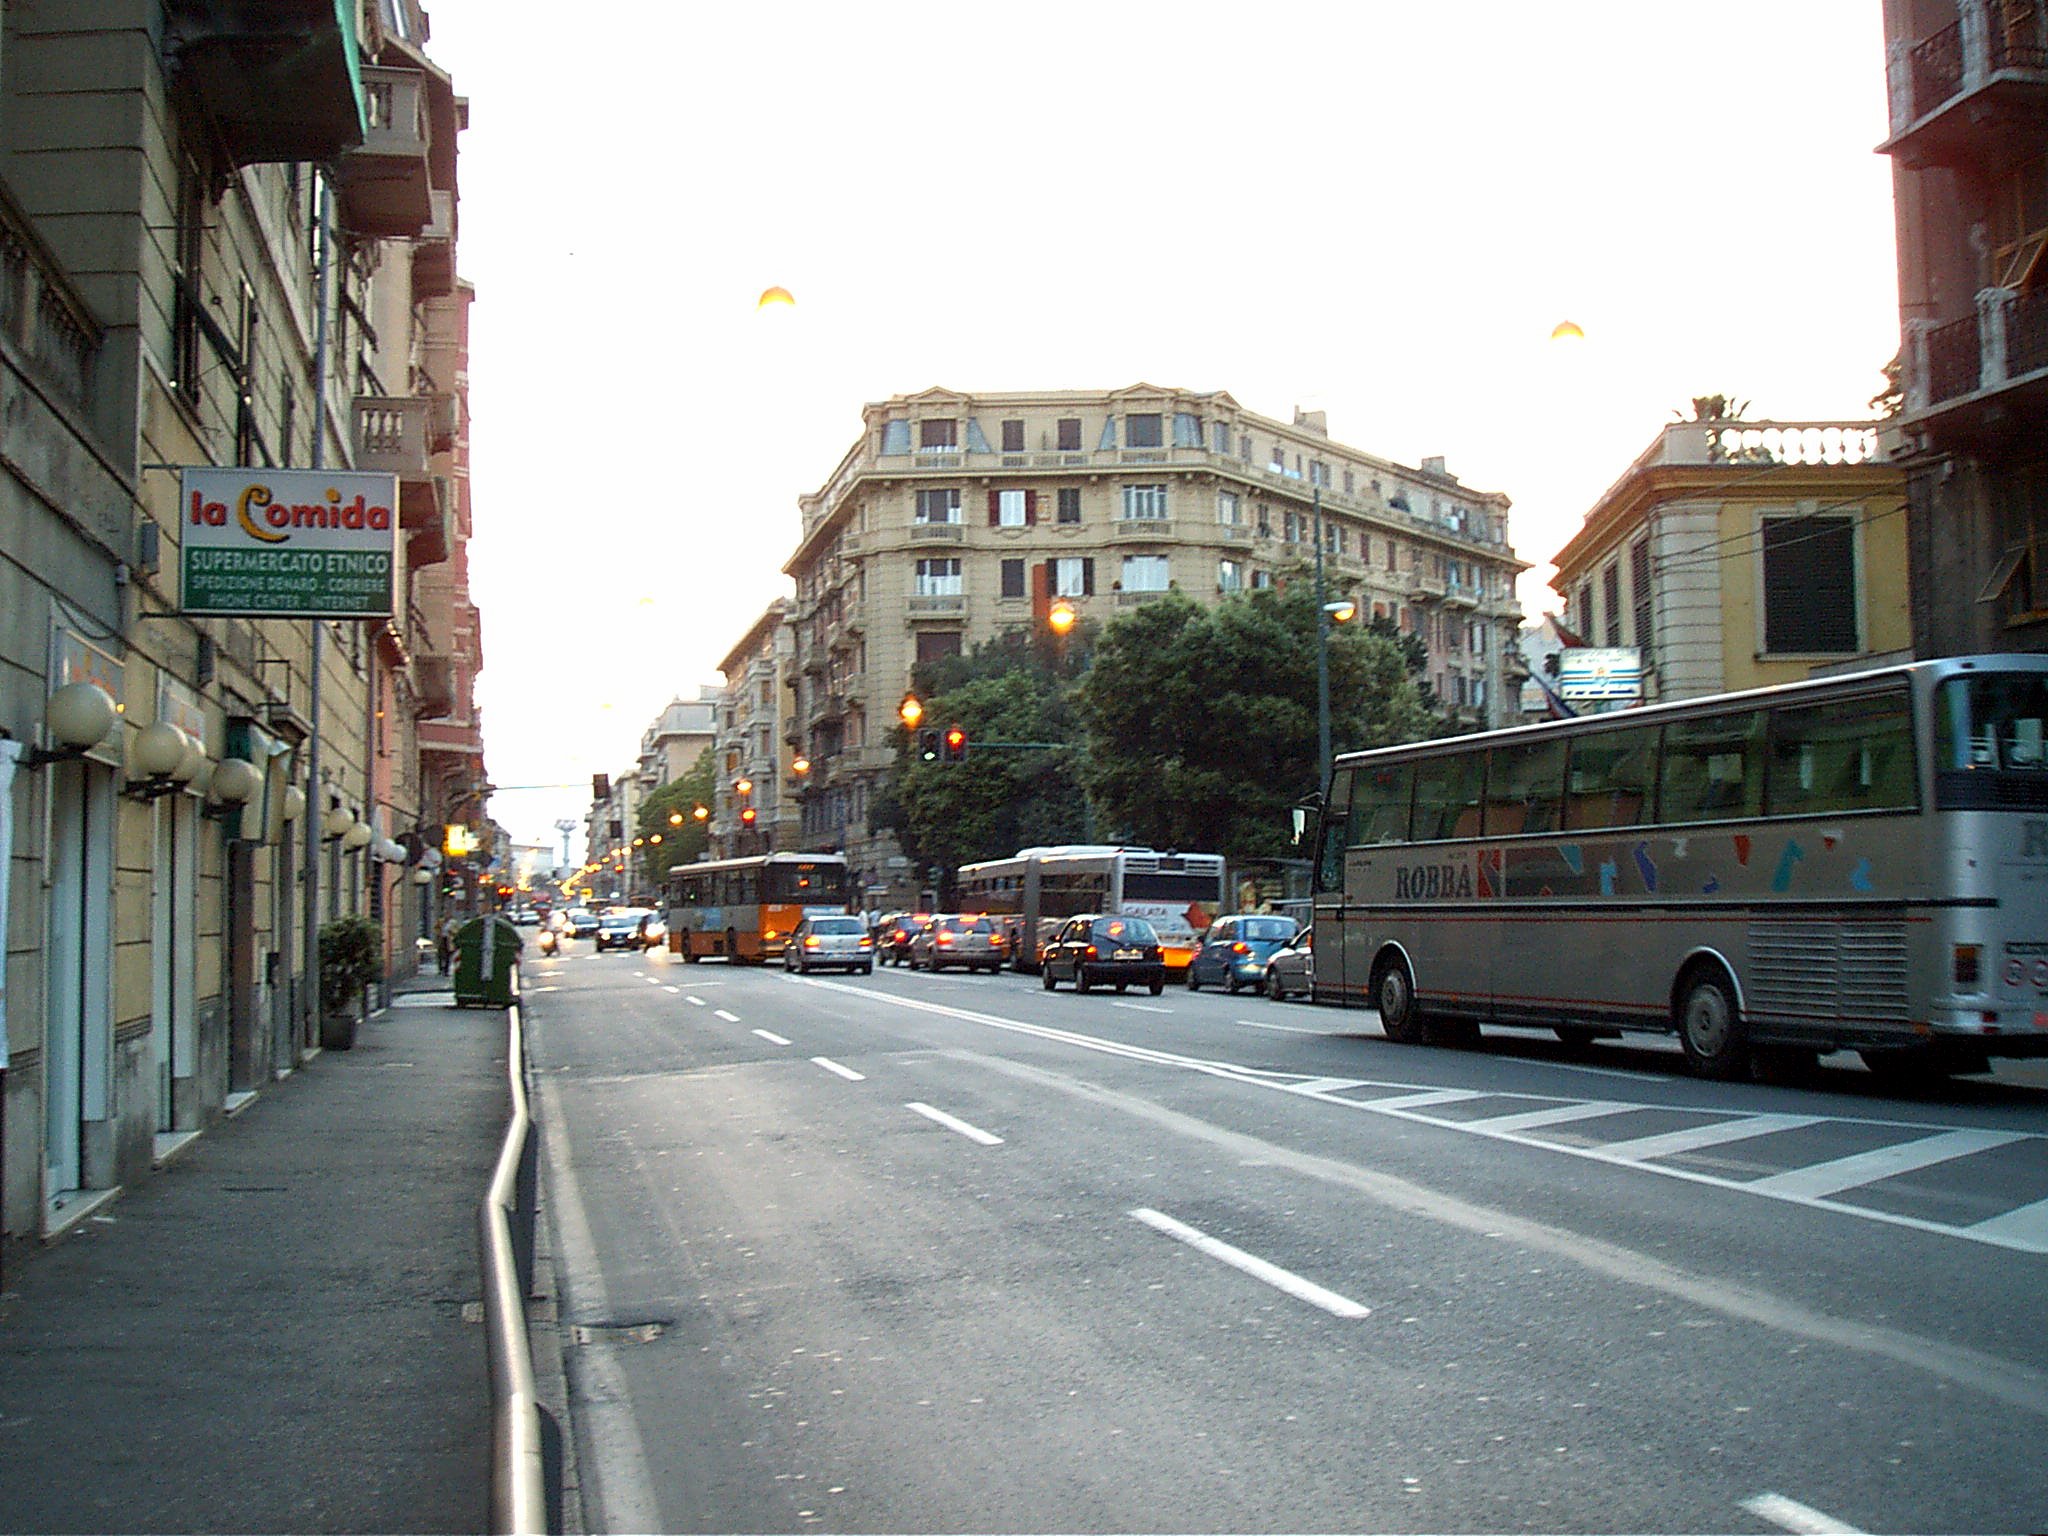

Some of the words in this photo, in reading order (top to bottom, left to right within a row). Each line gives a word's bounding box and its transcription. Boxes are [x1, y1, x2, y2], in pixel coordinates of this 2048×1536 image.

[190, 489, 227, 526] la
[236, 484, 390, 543] Comida
[190, 551, 323, 573] SUPERMERCATO
[326, 553, 389, 574] ETNICO
[191, 575, 265, 591] SPEDIZIONE
[267, 576, 318, 592] DENARO
[328, 577, 386, 593] CORRIERE
[208, 593, 252, 608] PHONE
[254, 594, 300, 609] CENTER
[310, 596, 369, 610] INTERNET
[1395, 863, 1472, 899] ROBBA
